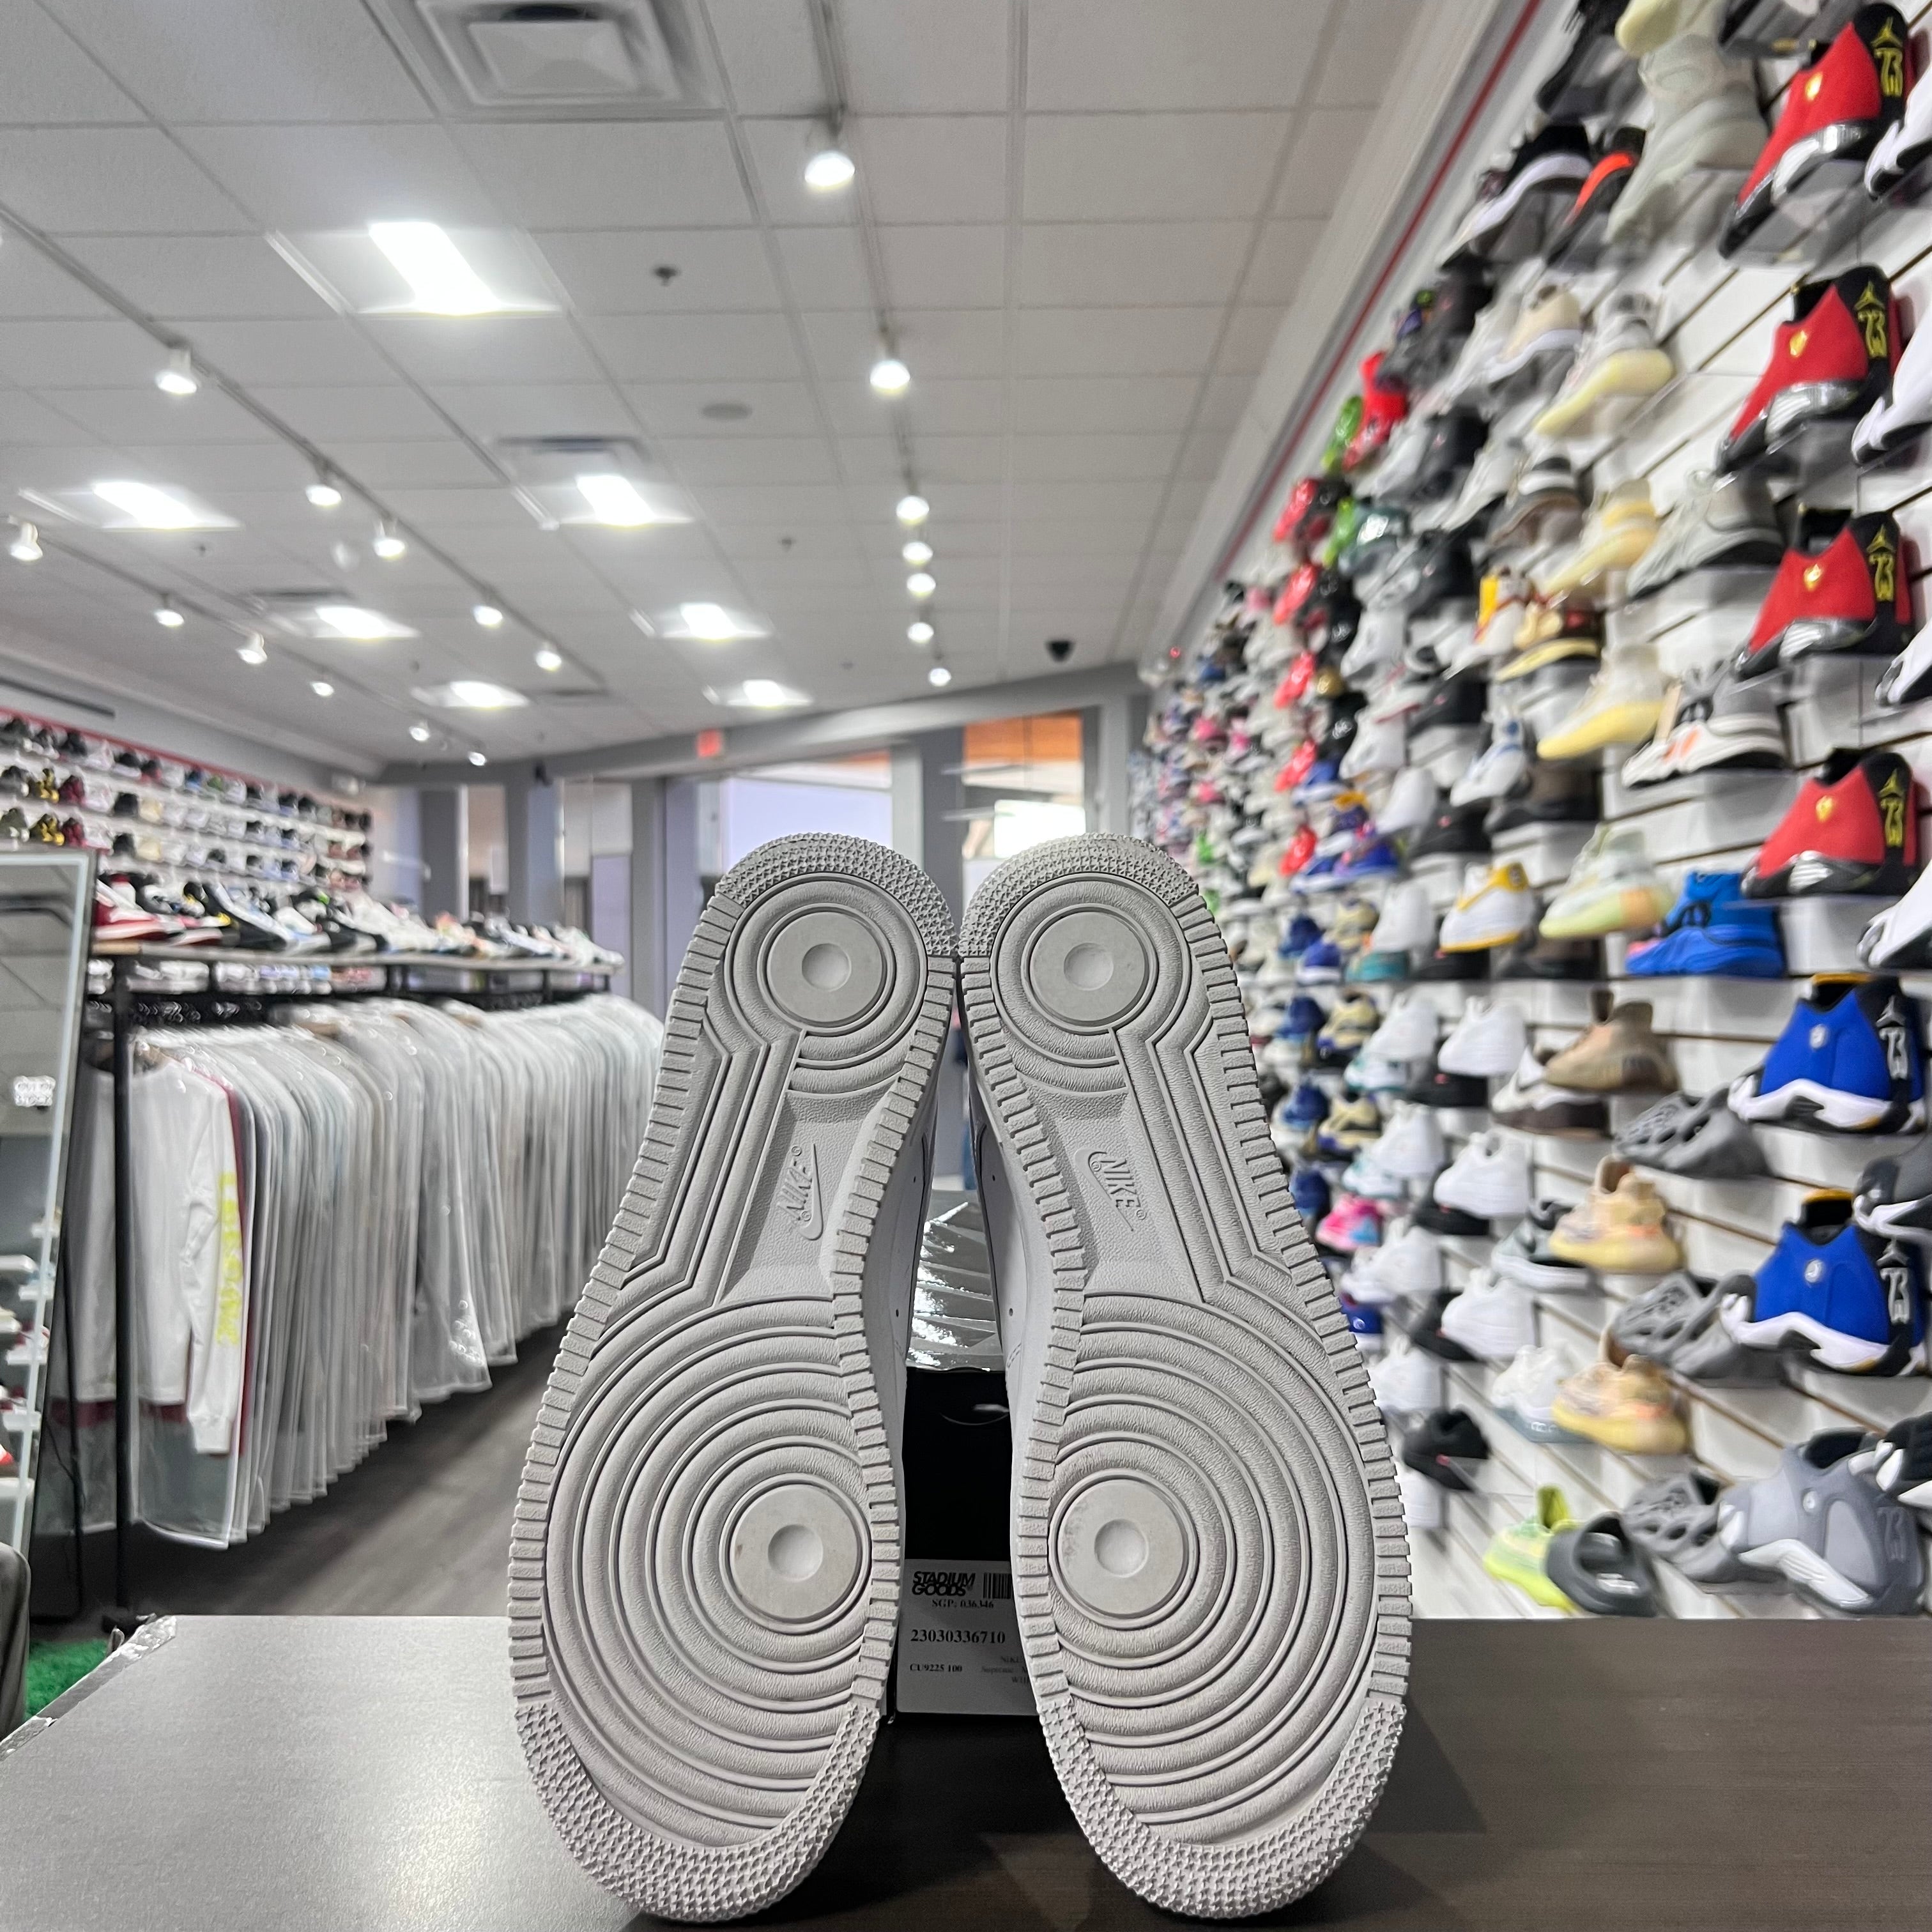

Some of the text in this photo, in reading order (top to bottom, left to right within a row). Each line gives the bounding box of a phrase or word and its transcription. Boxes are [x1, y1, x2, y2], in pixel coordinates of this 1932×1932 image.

[1099, 1157, 1142, 1209] NIKE
[913, 1571, 976, 1586] STADIUM
[912, 1583, 967, 1597] GOODS
[910, 1629, 1006, 1644] 23030336710
[947, 1664, 963, 1673] 100
